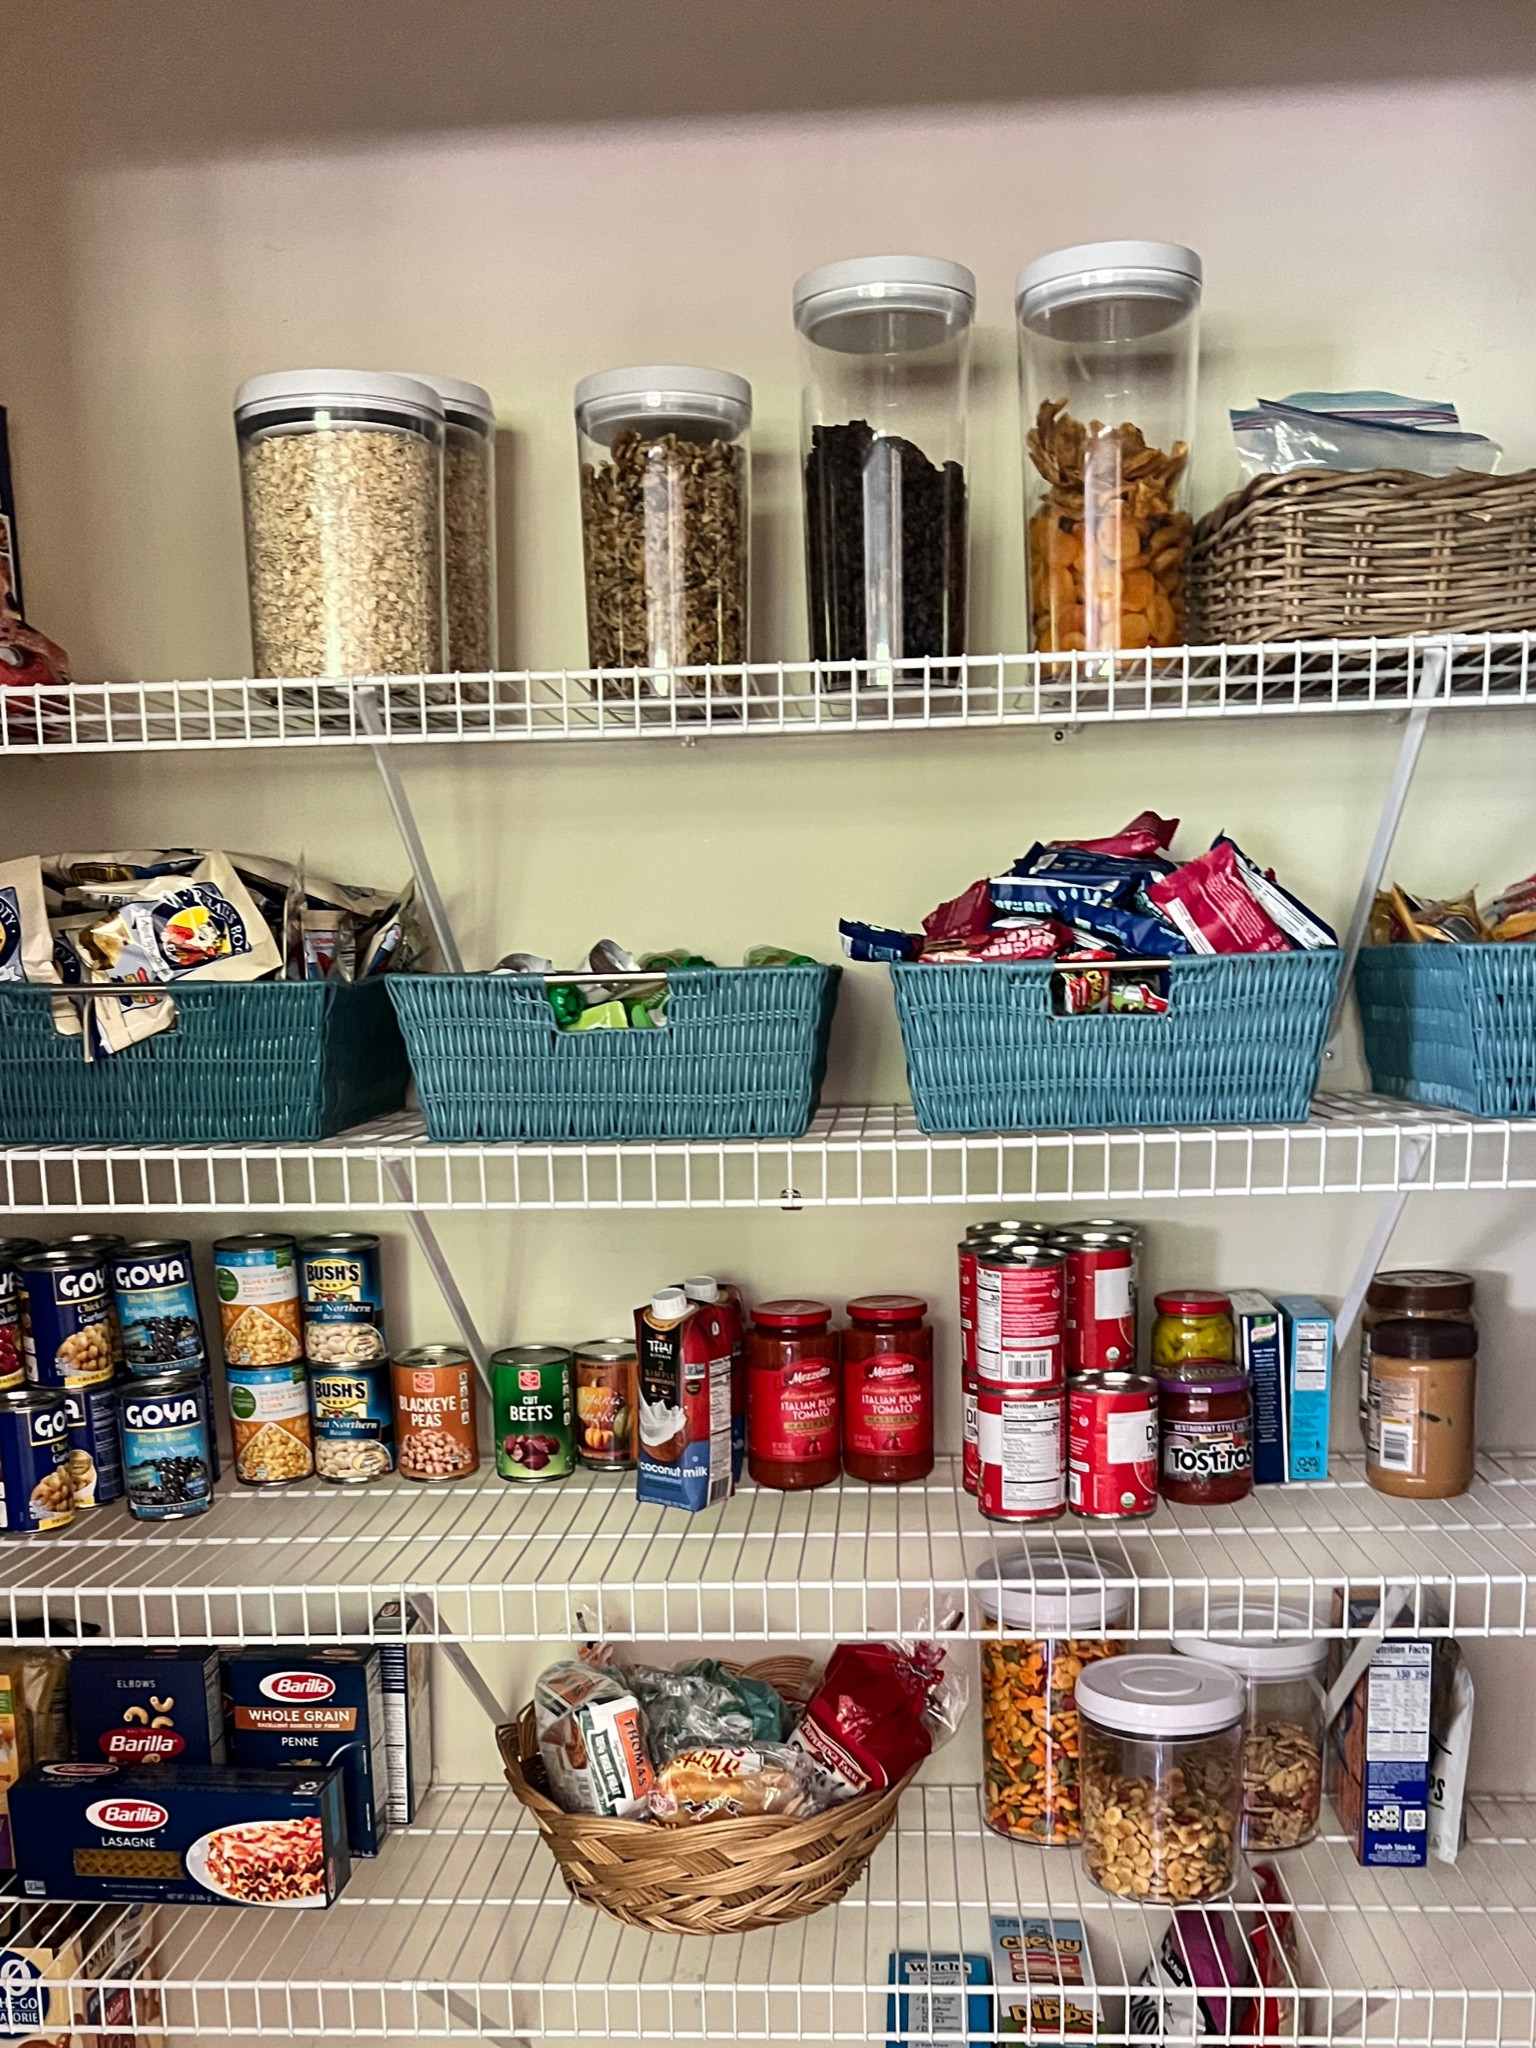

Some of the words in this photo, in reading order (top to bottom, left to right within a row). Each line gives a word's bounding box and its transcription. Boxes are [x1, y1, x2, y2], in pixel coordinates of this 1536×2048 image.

[116, 1260, 184, 1288] GOYA
[306, 1264, 359, 1282] BUSH'S
[326, 1303, 371, 1313] Northern
[647, 1339, 673, 1355] THAI
[315, 1382, 366, 1399] BUSH'S
[399, 1395, 457, 1413] BLACKEYE
[781, 1401, 816, 1412] ITALIAN
[862, 1394, 896, 1405] ITALIAN
[126, 1399, 197, 1428] GOYA
[510, 1405, 553, 1421] BEETS
[793, 1407, 830, 1420] TOMATO
[873, 1404, 913, 1415] TOMATO
[332, 1420, 377, 1430] Northern
[411, 1413, 442, 1427] PEAS
[640, 1461, 681, 1477] coconut
[683, 1466, 709, 1478] milk
[1408, 1645, 1430, 1655] Facts
[117, 1679, 156, 1688] ELBOWS
[277, 1679, 329, 1693] Barilla
[248, 1709, 300, 1722] WHOLE
[304, 1710, 349, 1722] GRAIN
[109, 1735, 174, 1752] Barilla
[281, 1737, 319, 1747] PENNE
[624, 1719, 647, 1787] THOMAS
[802, 1721, 839, 1762] PEPPERIDGE
[838, 1760, 859, 1783] FARM
[105, 1807, 160, 1823] Barilla
[101, 1836, 156, 1848] LASAGNE
